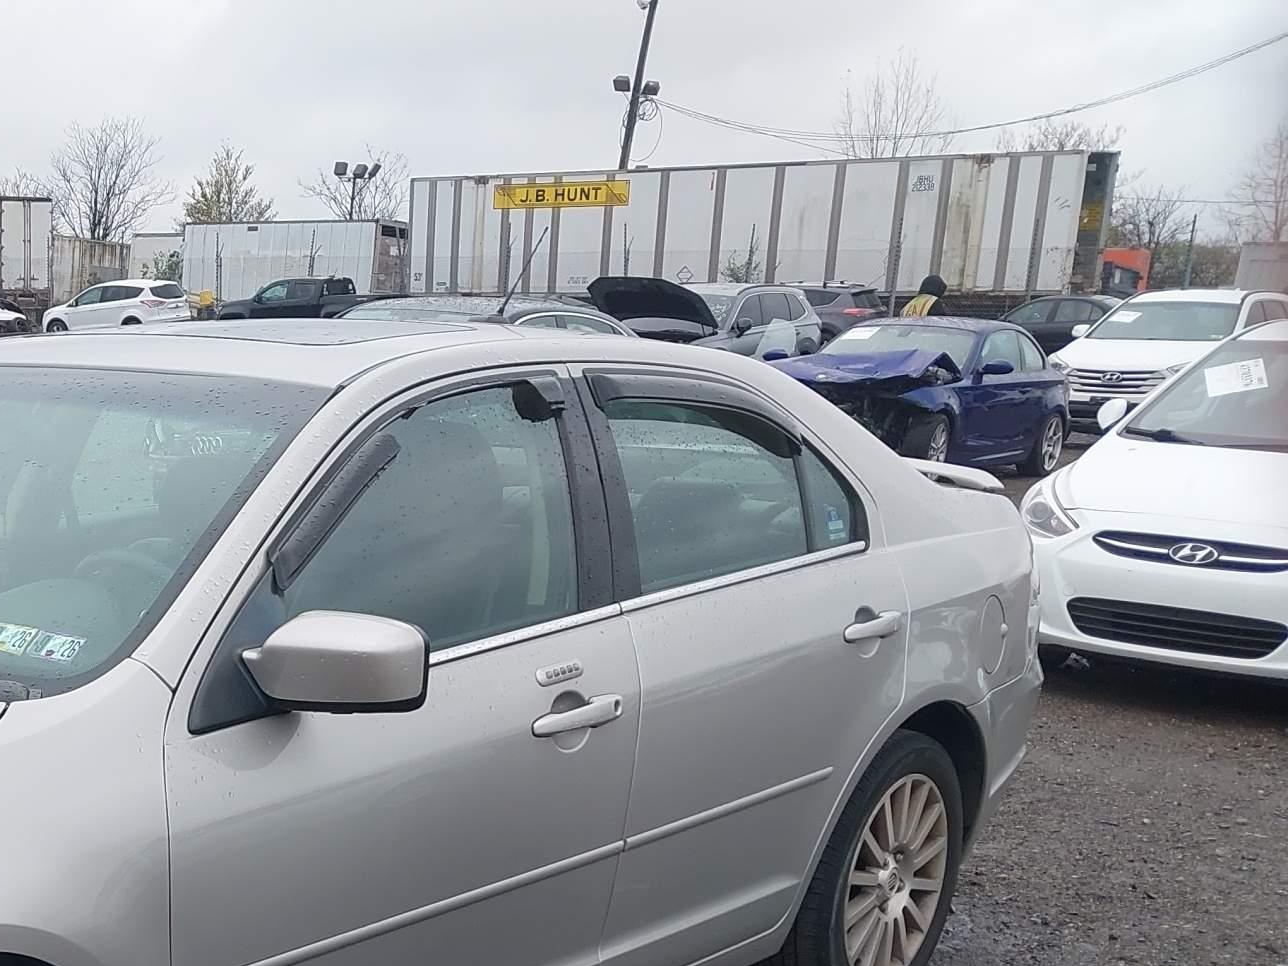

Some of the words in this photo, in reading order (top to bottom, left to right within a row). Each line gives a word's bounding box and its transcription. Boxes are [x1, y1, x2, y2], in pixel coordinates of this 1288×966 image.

[554, 186, 602, 202] HUNT
[12, 630, 32, 648] 26
[60, 640, 81, 658] 26
